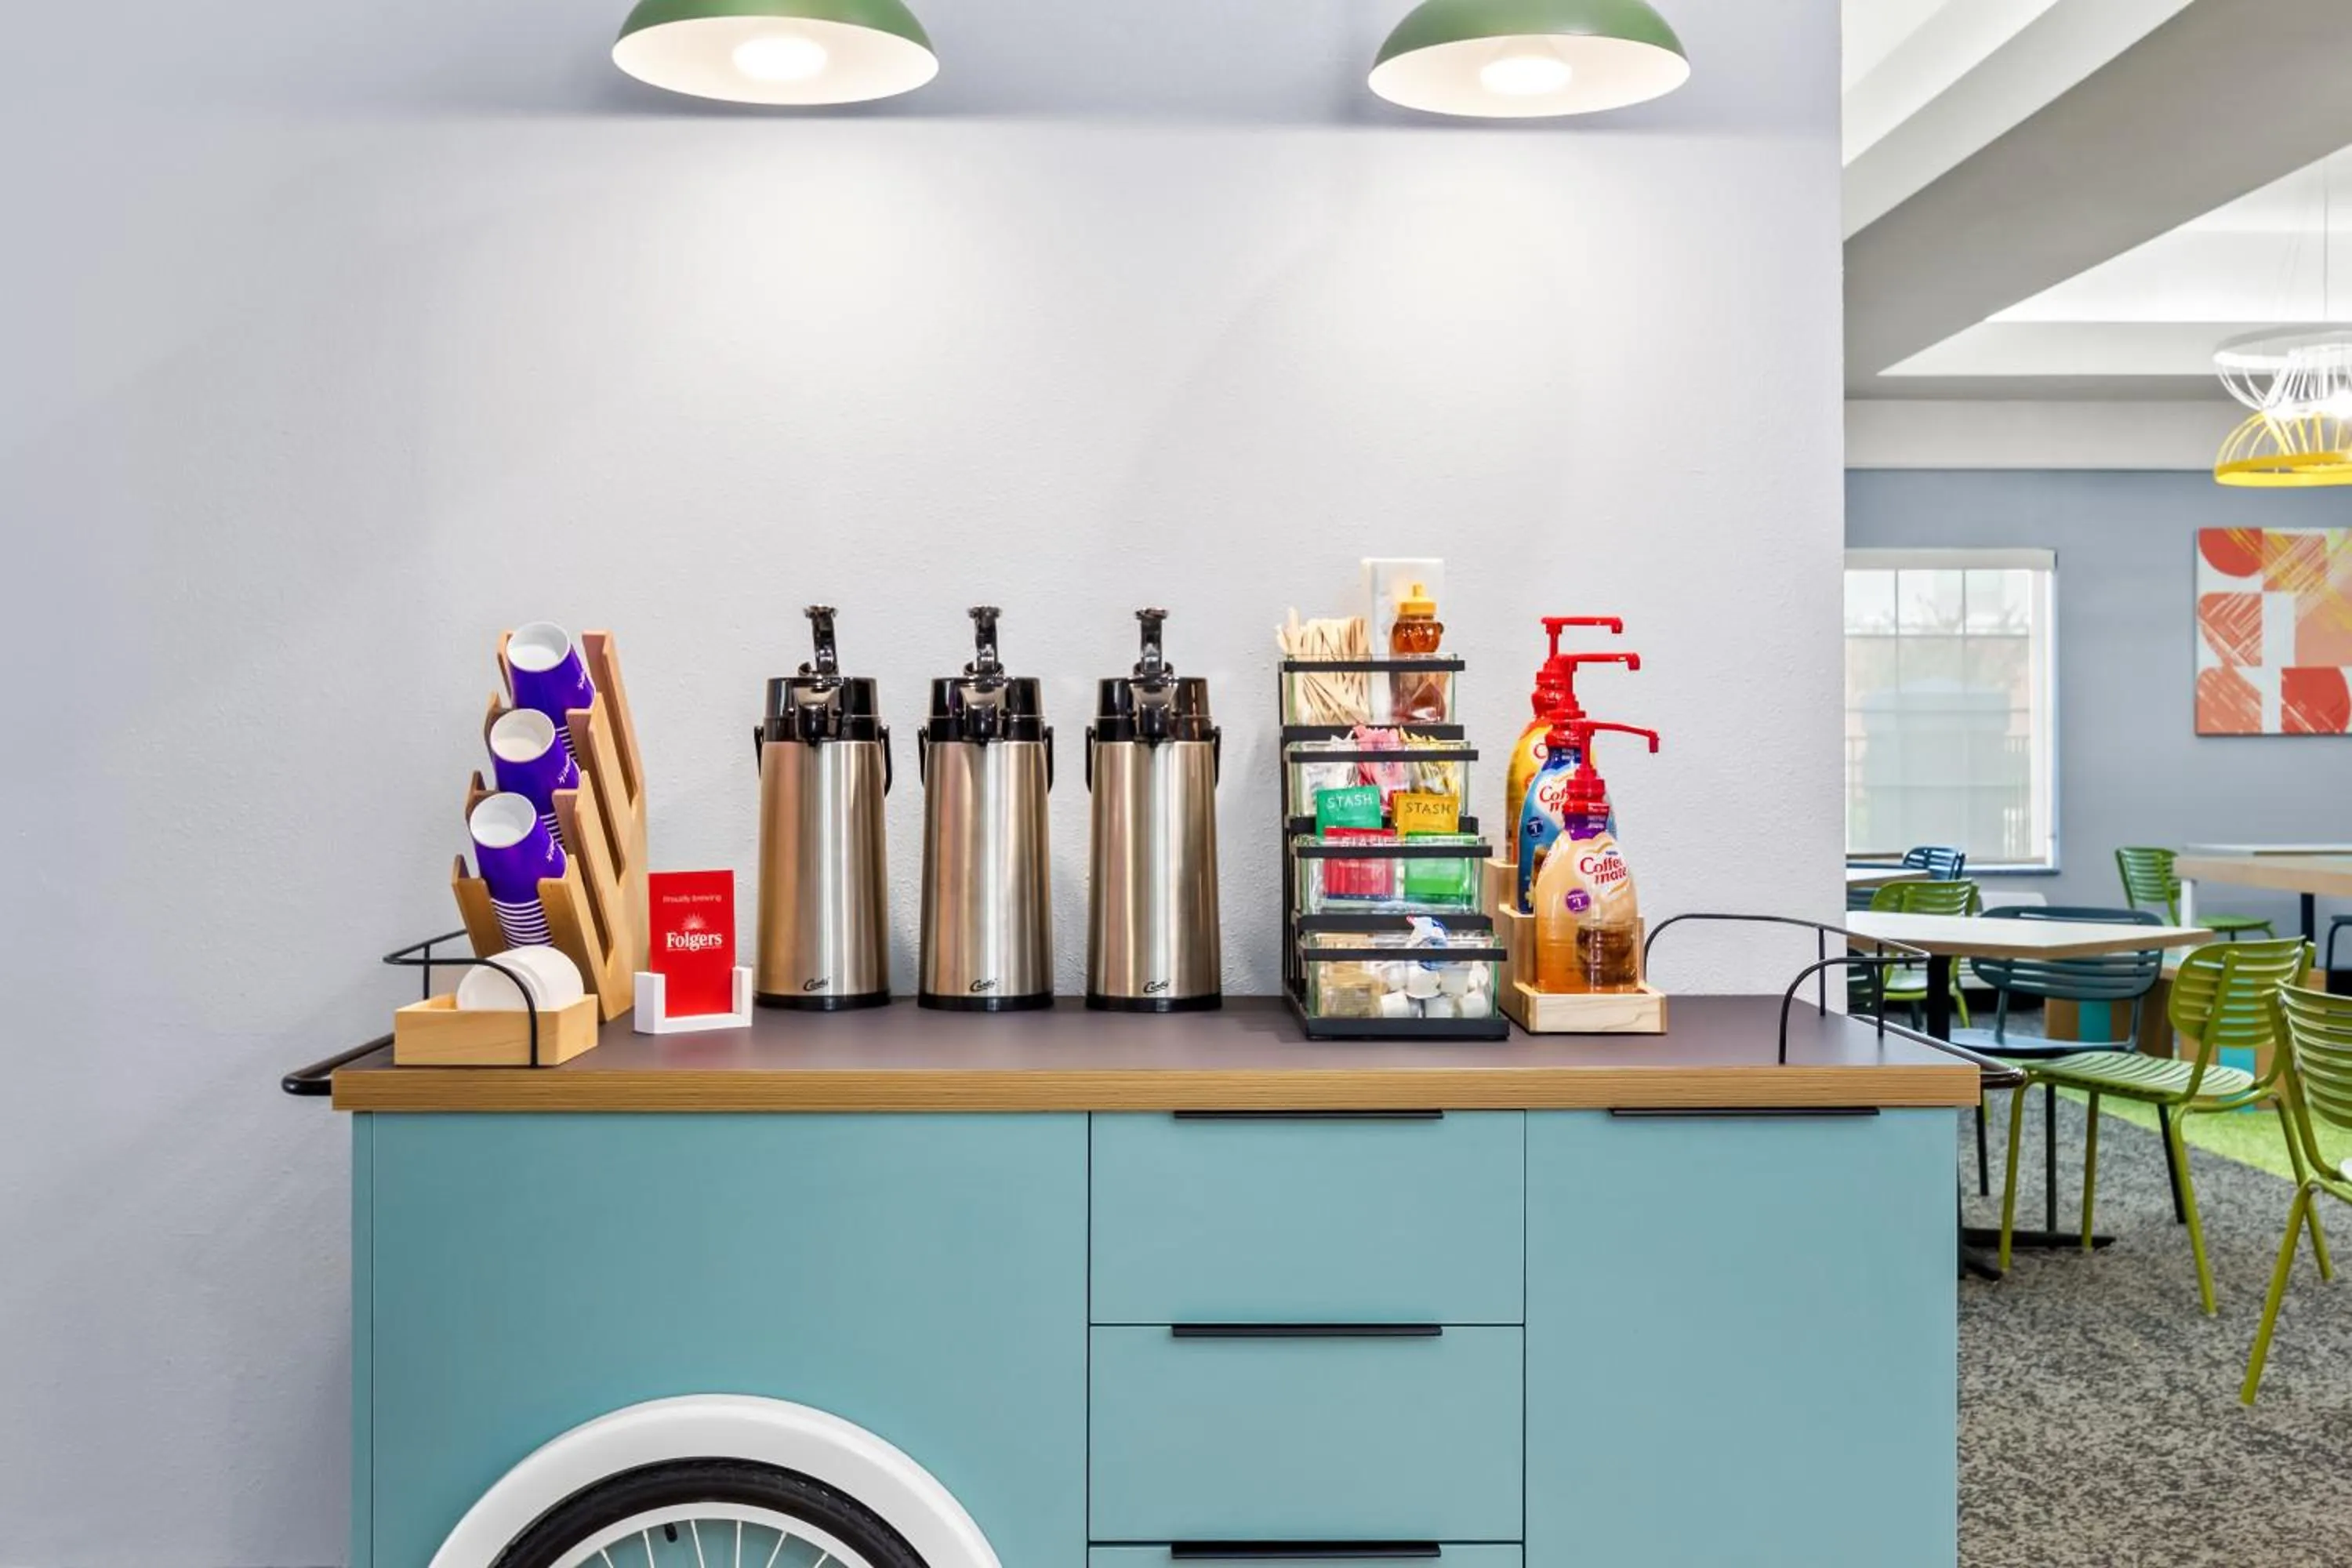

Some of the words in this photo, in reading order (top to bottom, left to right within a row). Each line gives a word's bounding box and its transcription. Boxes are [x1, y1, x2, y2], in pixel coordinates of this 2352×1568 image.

[1326, 793, 1373, 810] STASH
[1405, 801, 1452, 815] STASH
[666, 931, 723, 952] Folgers
